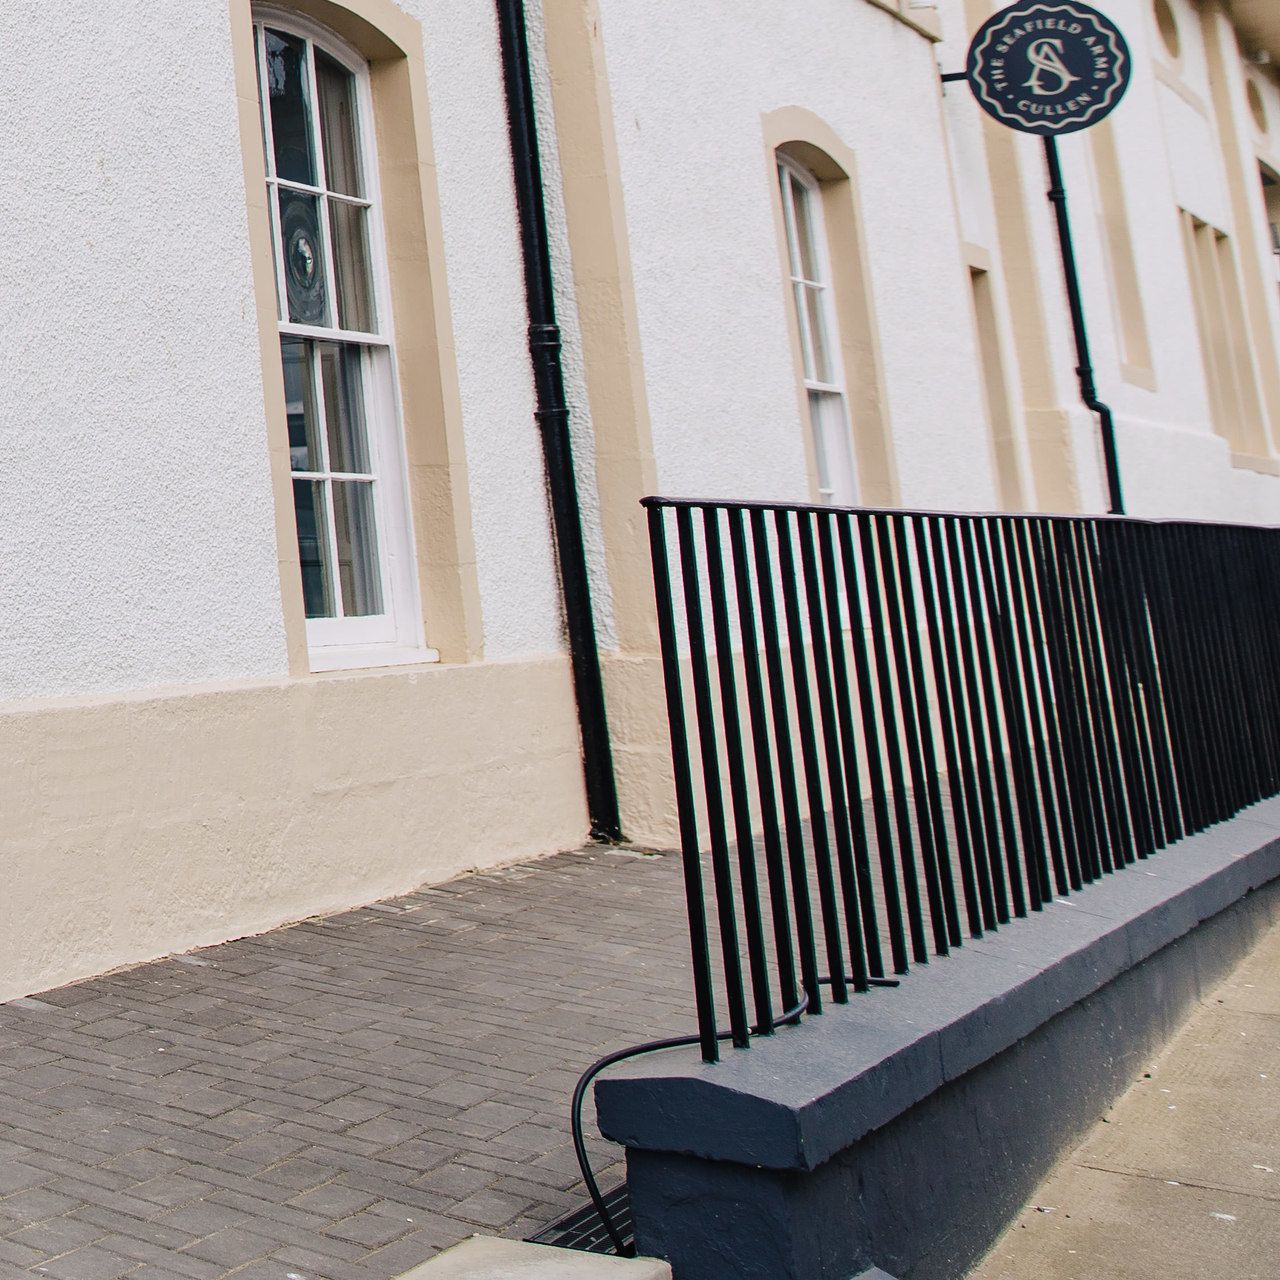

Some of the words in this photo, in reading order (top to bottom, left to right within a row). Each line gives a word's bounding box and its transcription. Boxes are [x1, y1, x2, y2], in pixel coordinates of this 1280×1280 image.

[996, 18, 1082, 54] SEAFIELD
[990, 58, 1008, 92] THE
[1081, 36, 1109, 79] ARMS
[1017, 92, 1092, 115] CULLEN
